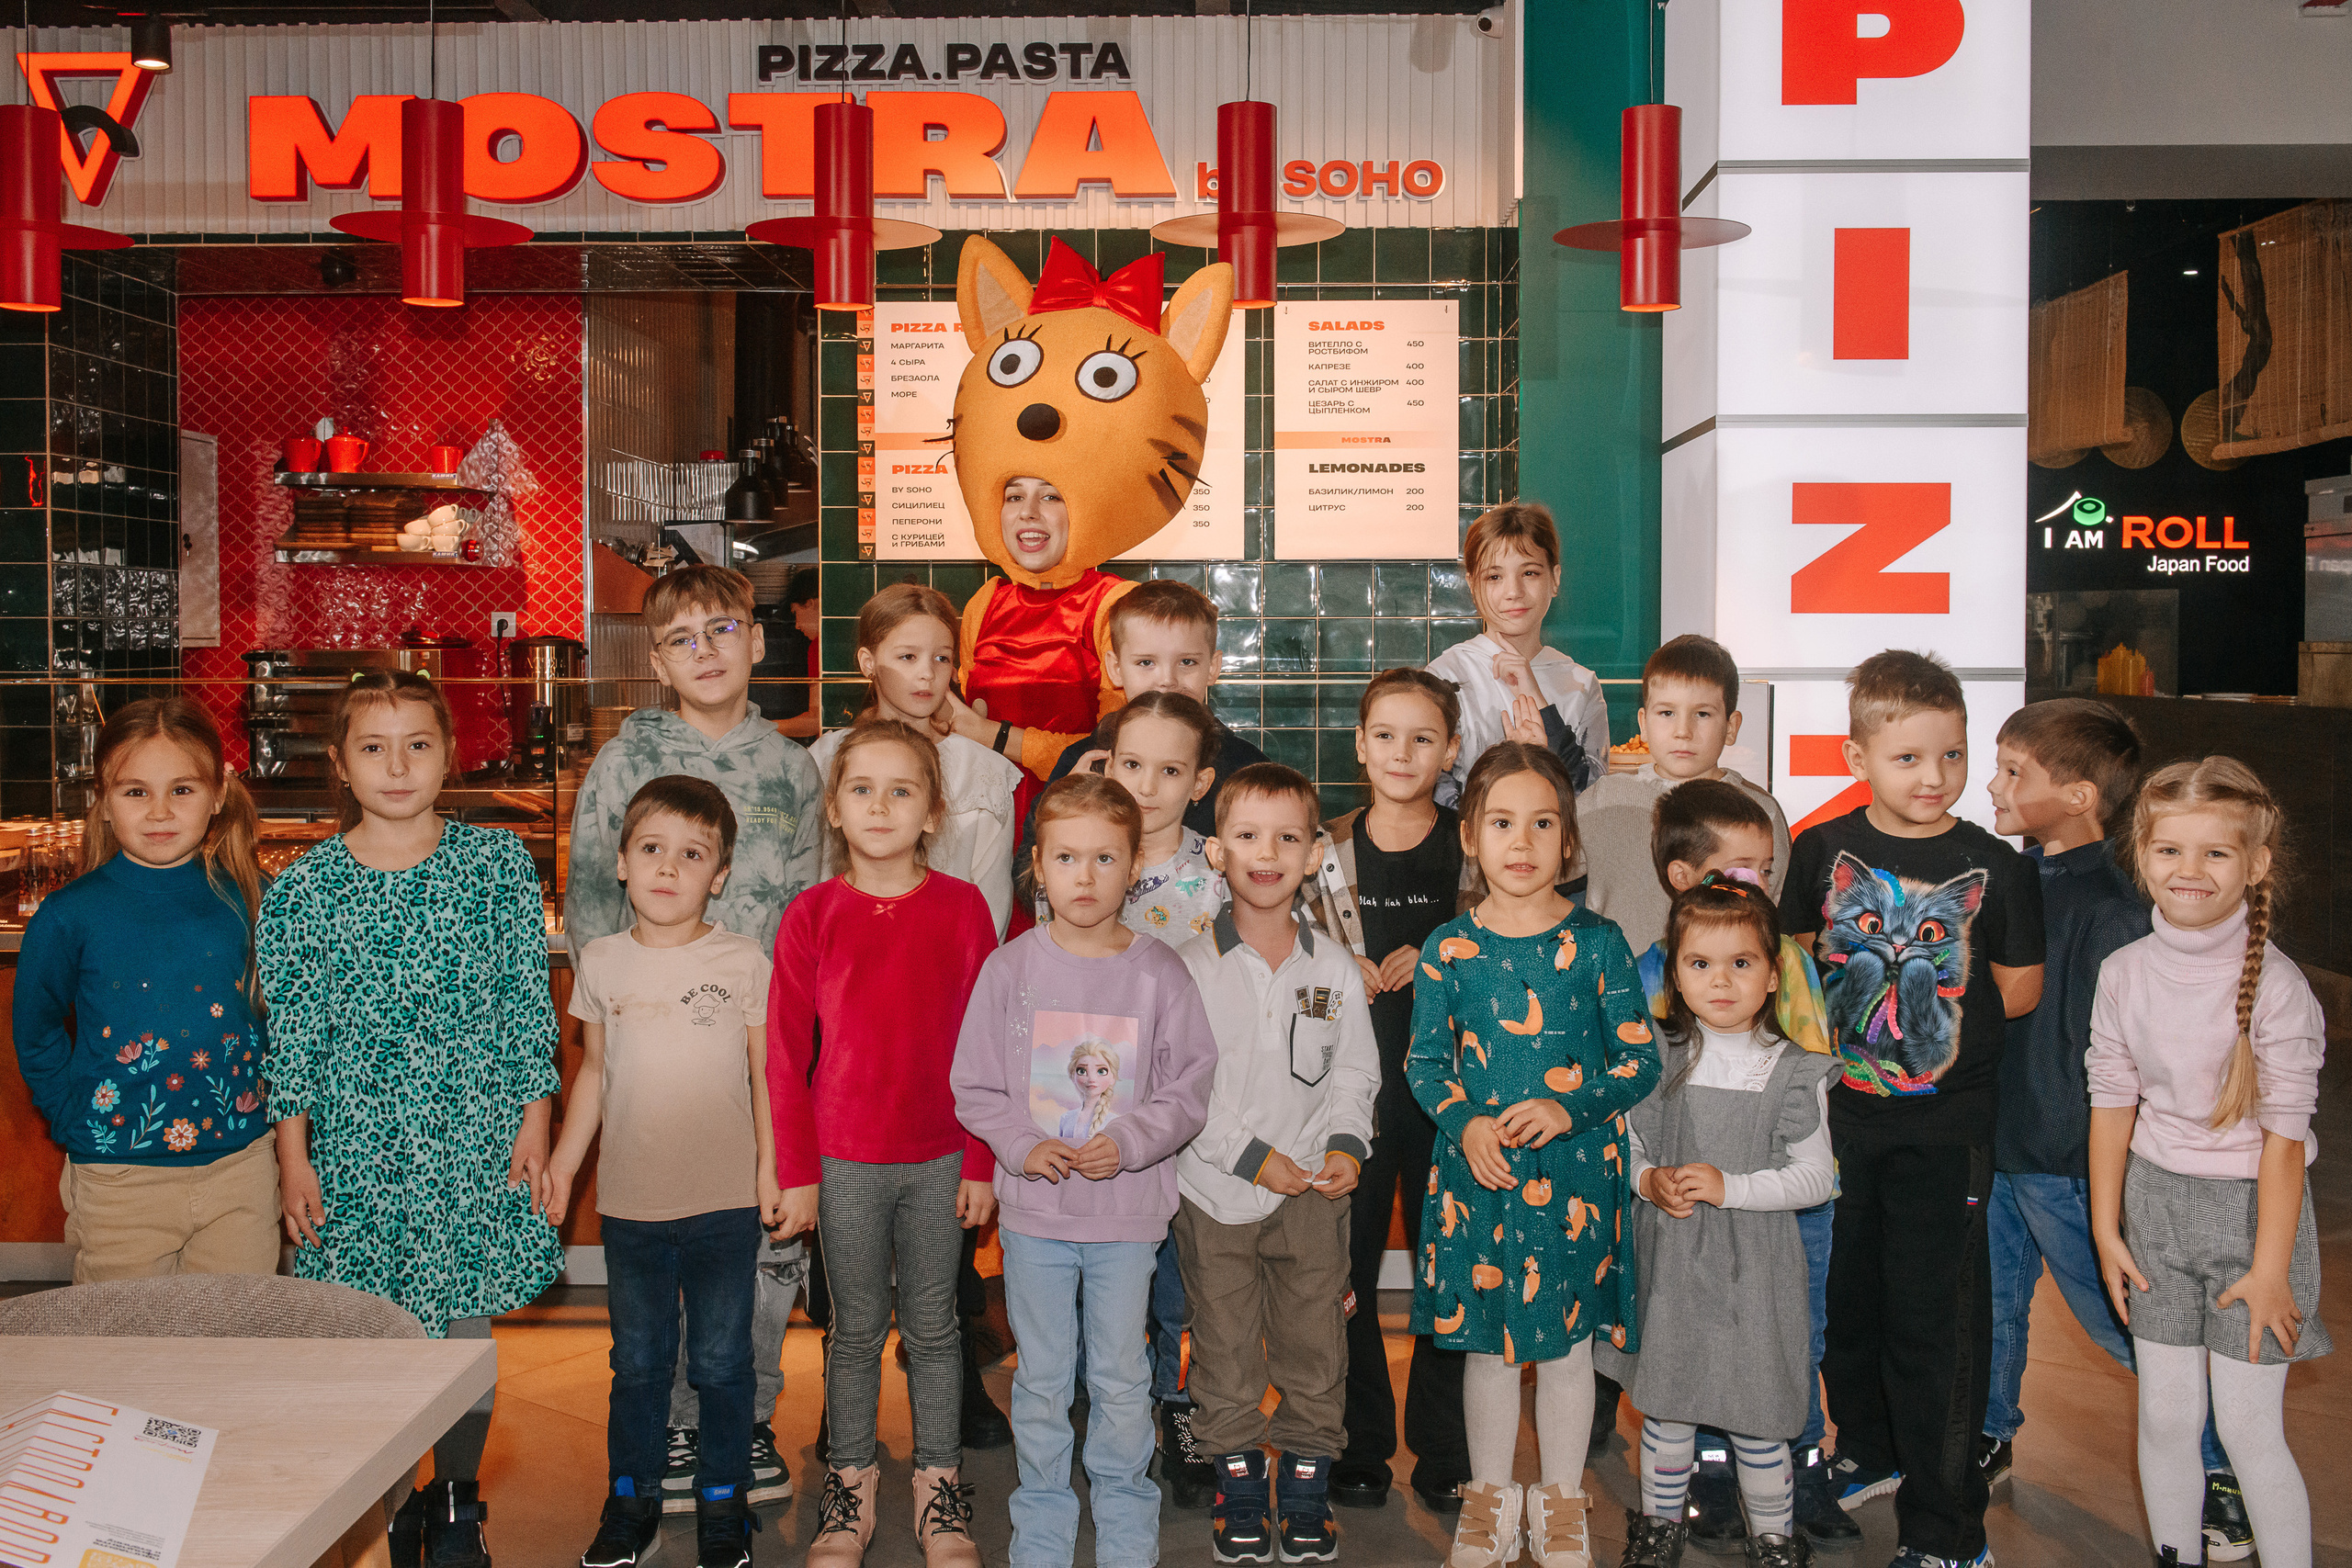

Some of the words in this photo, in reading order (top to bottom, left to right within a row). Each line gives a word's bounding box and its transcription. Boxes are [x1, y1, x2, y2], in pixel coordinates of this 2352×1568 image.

[757, 41, 1131, 82] PIZZA.PASTA
[249, 91, 1179, 201] MOSTRA
[1283, 160, 1443, 197] SOHO
[890, 322, 947, 333] PIZZA
[1308, 321, 1385, 332] SALADS
[891, 465, 948, 475] PIZZA
[1308, 463, 1426, 473] LEMONADES
[900, 533, 944, 541] КУРИЦЕЙ
[2044, 527, 2052, 548] I
[2064, 530, 2104, 549] AM
[2121, 516, 2250, 549] ROLL
[2147, 555, 2200, 576] Japan
[2206, 555, 2250, 572] Food
[680, 988, 698, 1005] BE
[700, 984, 731, 1003] COOL
